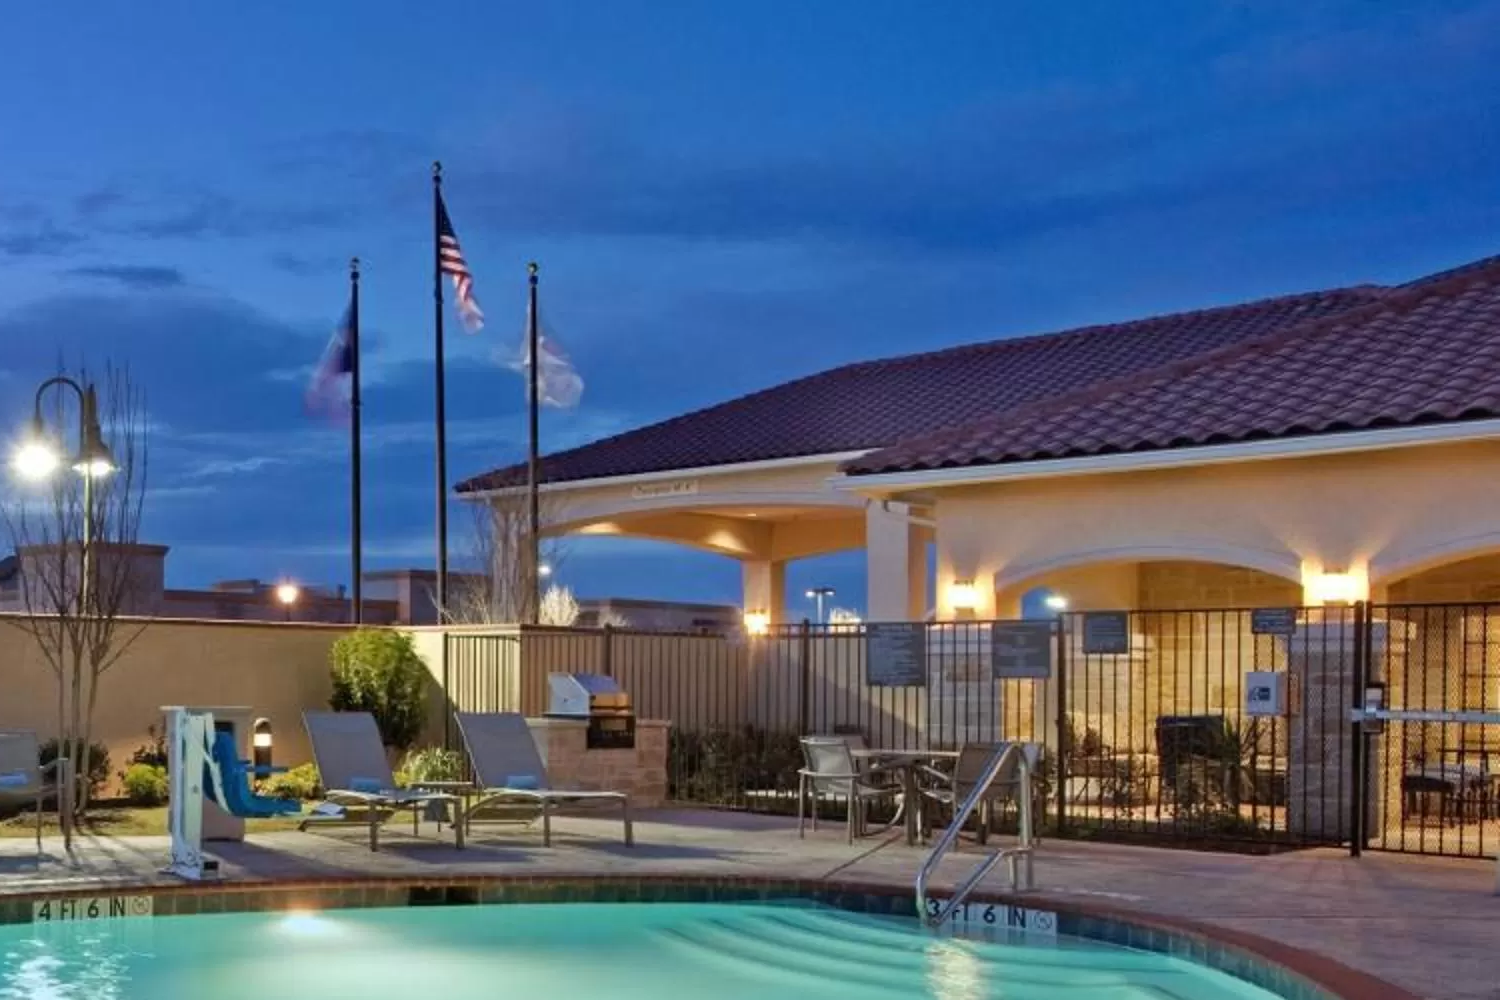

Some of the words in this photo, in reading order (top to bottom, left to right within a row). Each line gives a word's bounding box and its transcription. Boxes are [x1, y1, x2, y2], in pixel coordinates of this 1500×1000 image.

[38, 902, 52, 920] 4
[60, 900, 76, 920] FT
[87, 899, 100, 918] 6
[109, 897, 125, 917] IN
[927, 899, 941, 918] 3
[983, 905, 996, 924] 6
[1007, 905, 1027, 928] IN
